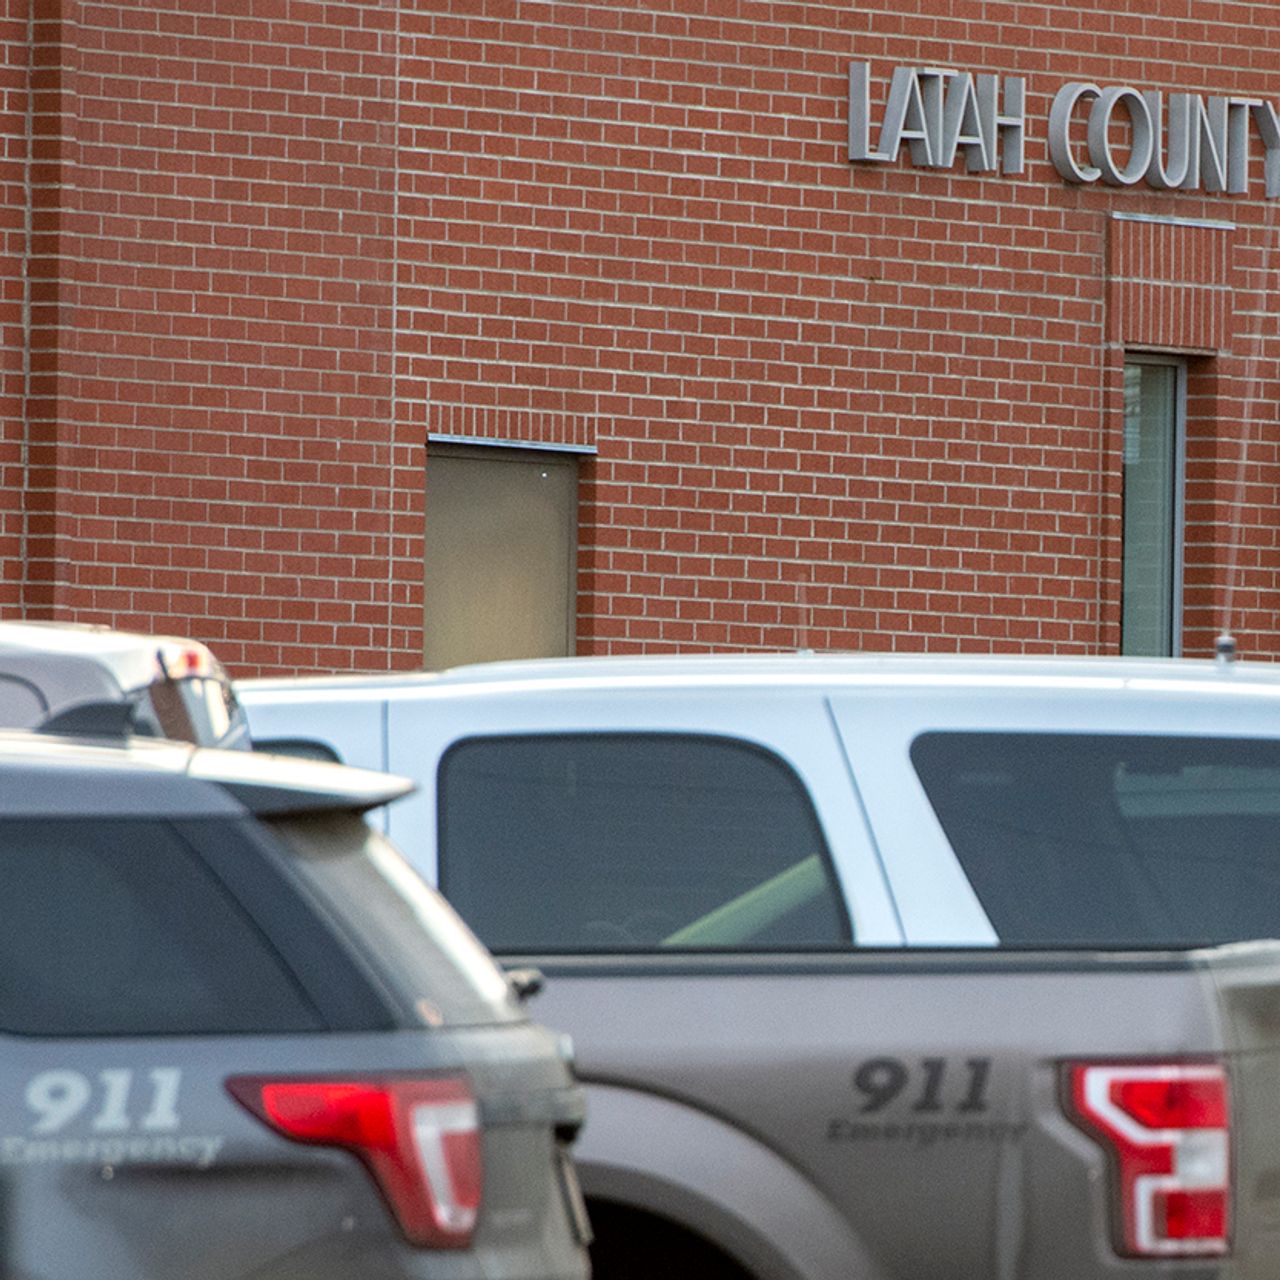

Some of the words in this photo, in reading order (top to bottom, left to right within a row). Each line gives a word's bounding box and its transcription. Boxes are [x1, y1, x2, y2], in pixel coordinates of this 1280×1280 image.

[848, 61, 1025, 174] LATAH
[26, 1067, 183, 1135] 911
[853, 1056, 991, 1114] 911
[0, 1136, 224, 1168] Emergency
